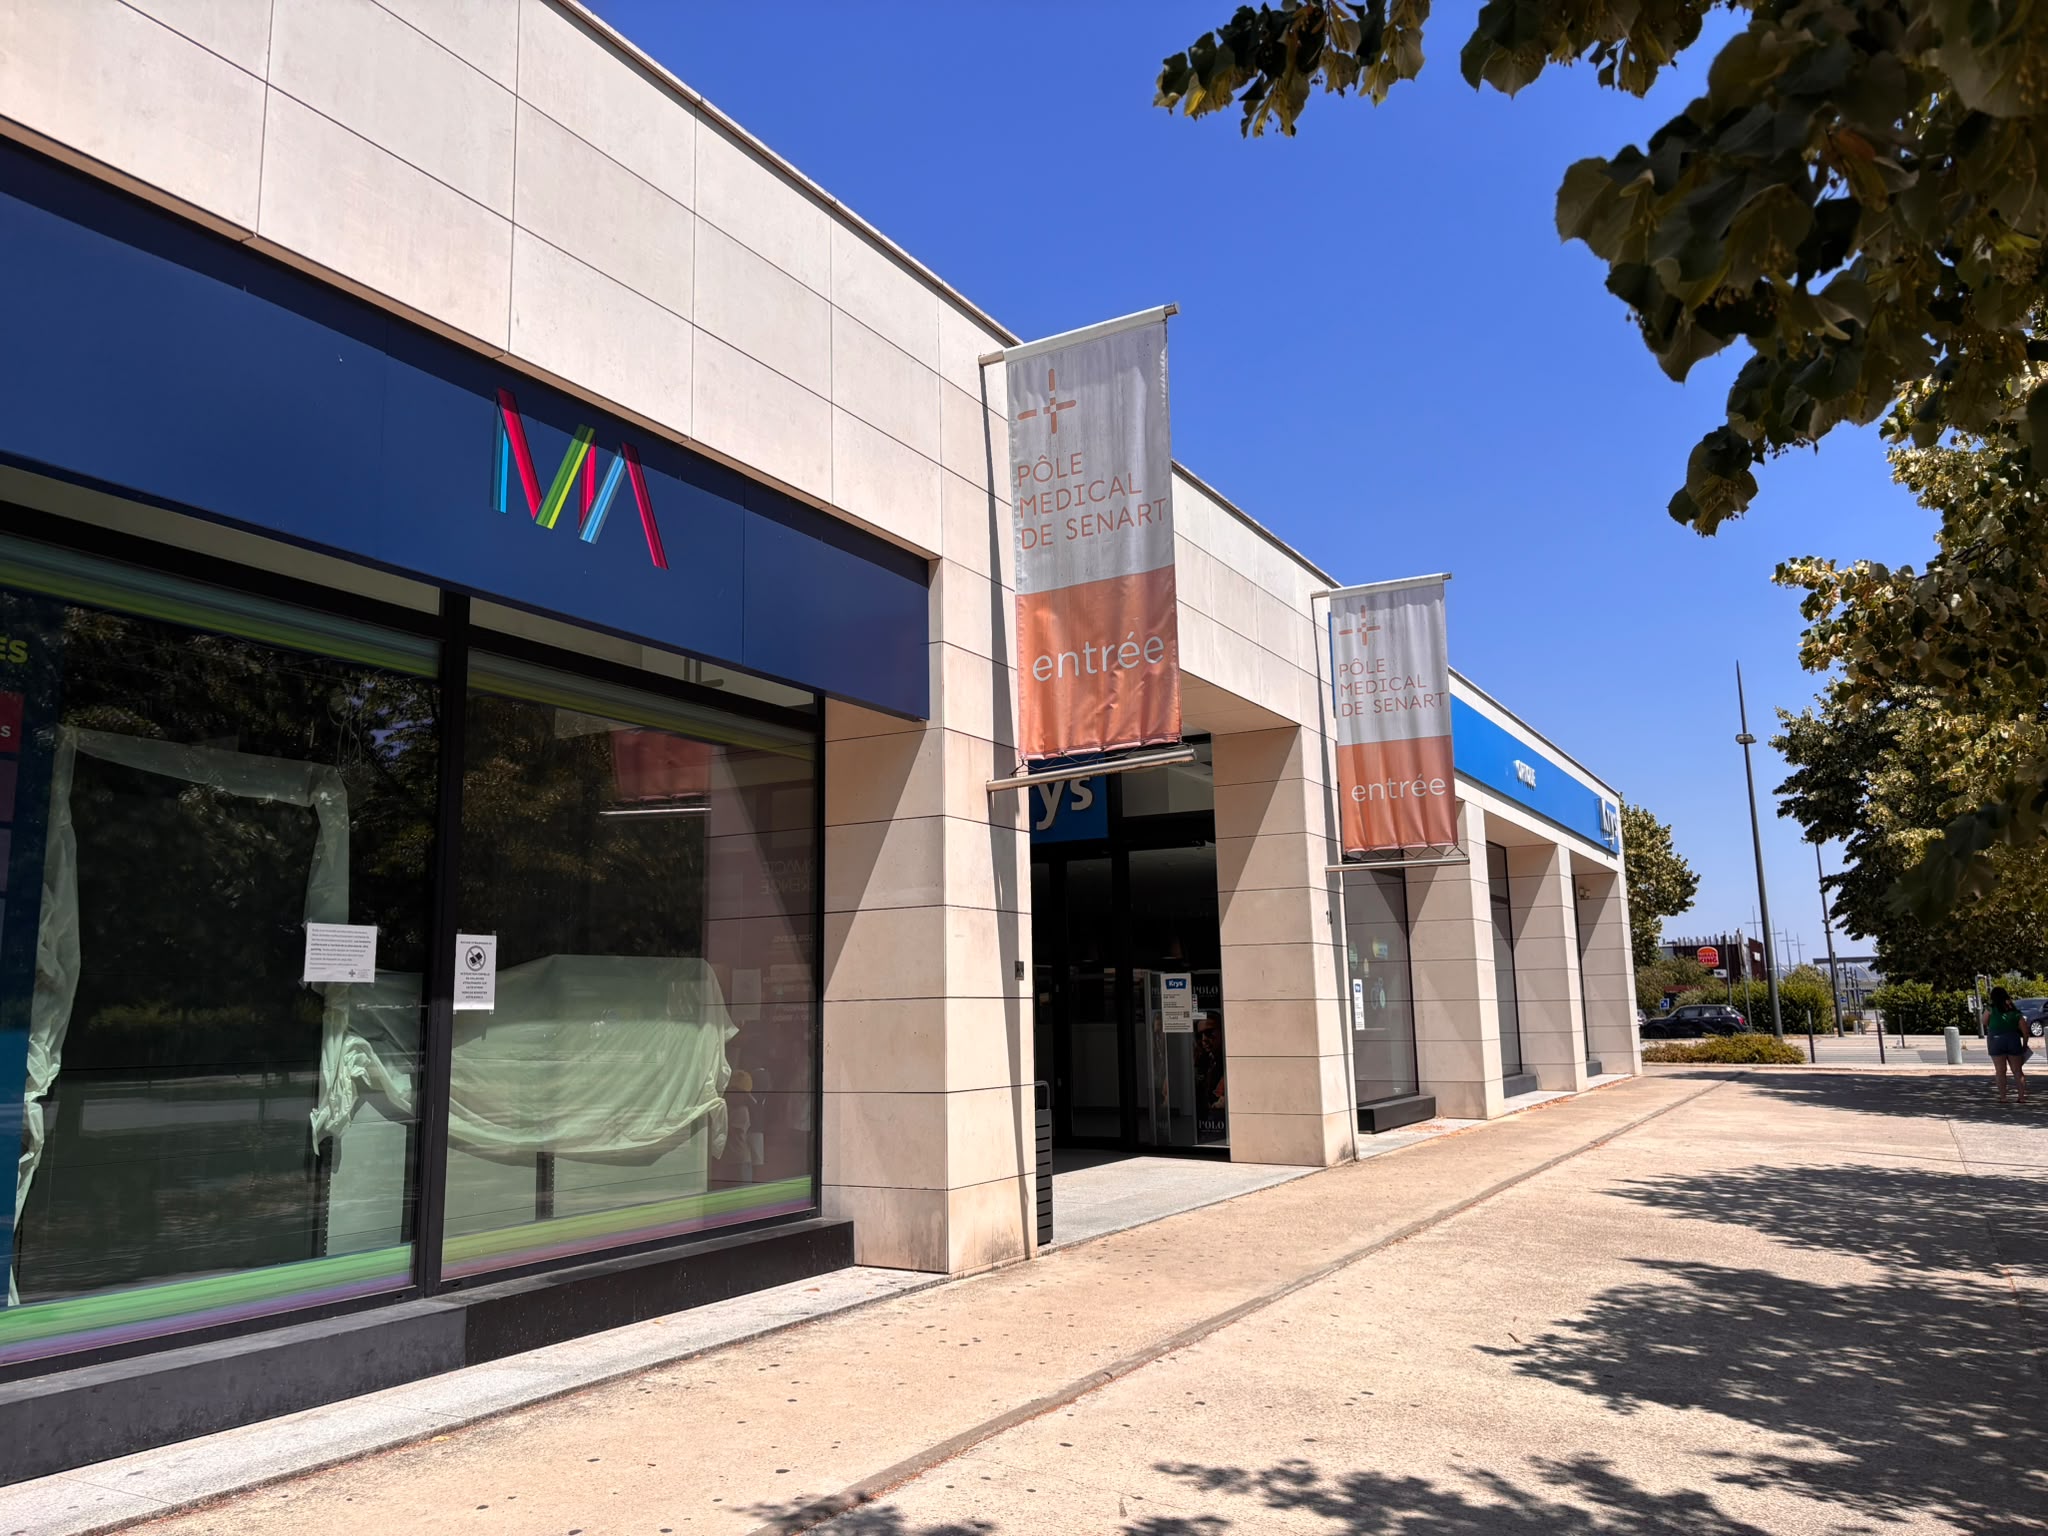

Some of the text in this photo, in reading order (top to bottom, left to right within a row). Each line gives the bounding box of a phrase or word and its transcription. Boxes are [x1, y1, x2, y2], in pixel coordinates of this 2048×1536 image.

[1018, 452, 1083, 487] PÔLE
[1019, 472, 1142, 519] MEDICAL
[1021, 498, 1166, 549] DE SENART
[1033, 631, 1164, 682] entrée
[1339, 658, 1385, 677] PÔLE
[1340, 674, 1427, 697] MEDICAL
[1342, 692, 1445, 717] DE SENART
[1351, 773, 1446, 802] entrée
[1030, 776, 1093, 830] ys
[1193, 985, 1219, 995] POLO
[1198, 1119, 1225, 1129] POLO
